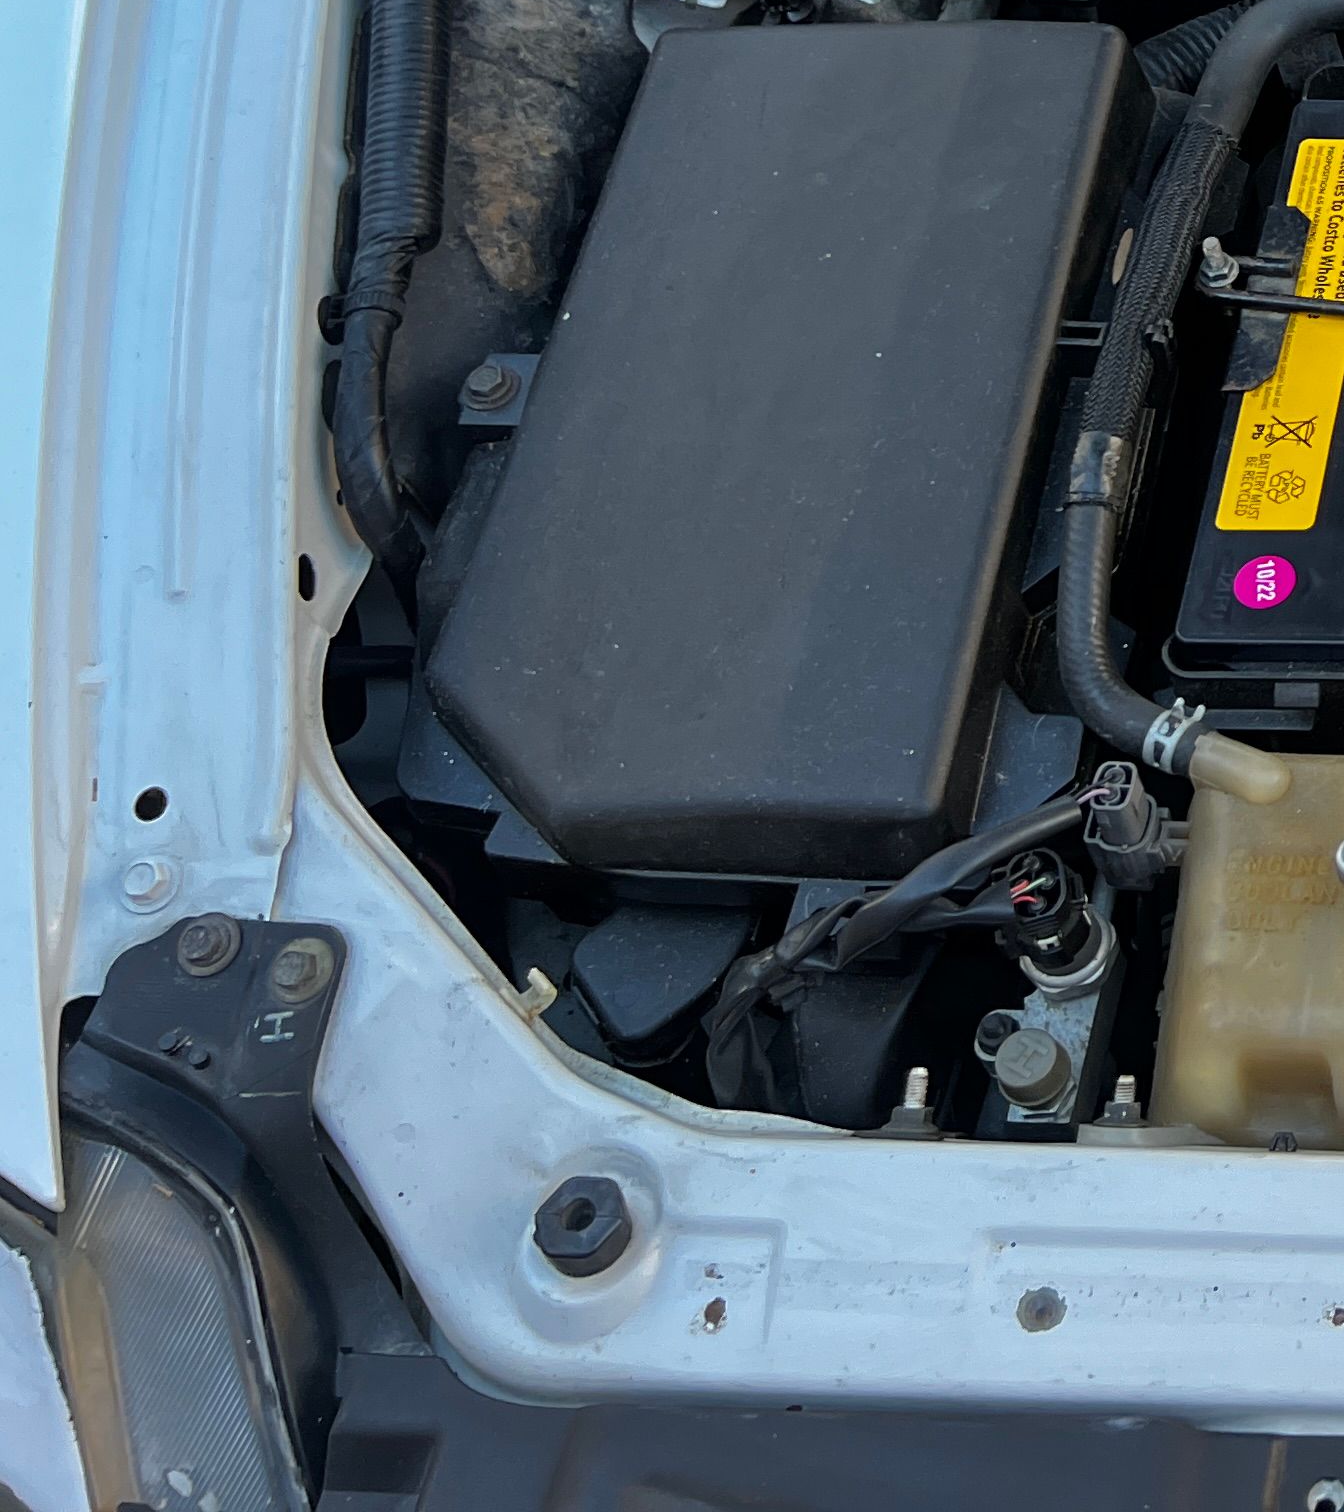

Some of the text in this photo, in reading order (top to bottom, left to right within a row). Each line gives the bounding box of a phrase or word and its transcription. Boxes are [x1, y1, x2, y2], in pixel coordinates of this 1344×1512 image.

[1317, 146, 1335, 194] PROPOSITION
[1315, 196, 1325, 205] 65
[1331, 200, 1344, 211] to
[1322, 215, 1344, 252] Costco
[1251, 424, 1265, 440] Pb
[1234, 457, 1257, 517] BE RECYCLED
[1246, 453, 1272, 520] BATTERY MUST
[1255, 560, 1276, 602] 10/22
